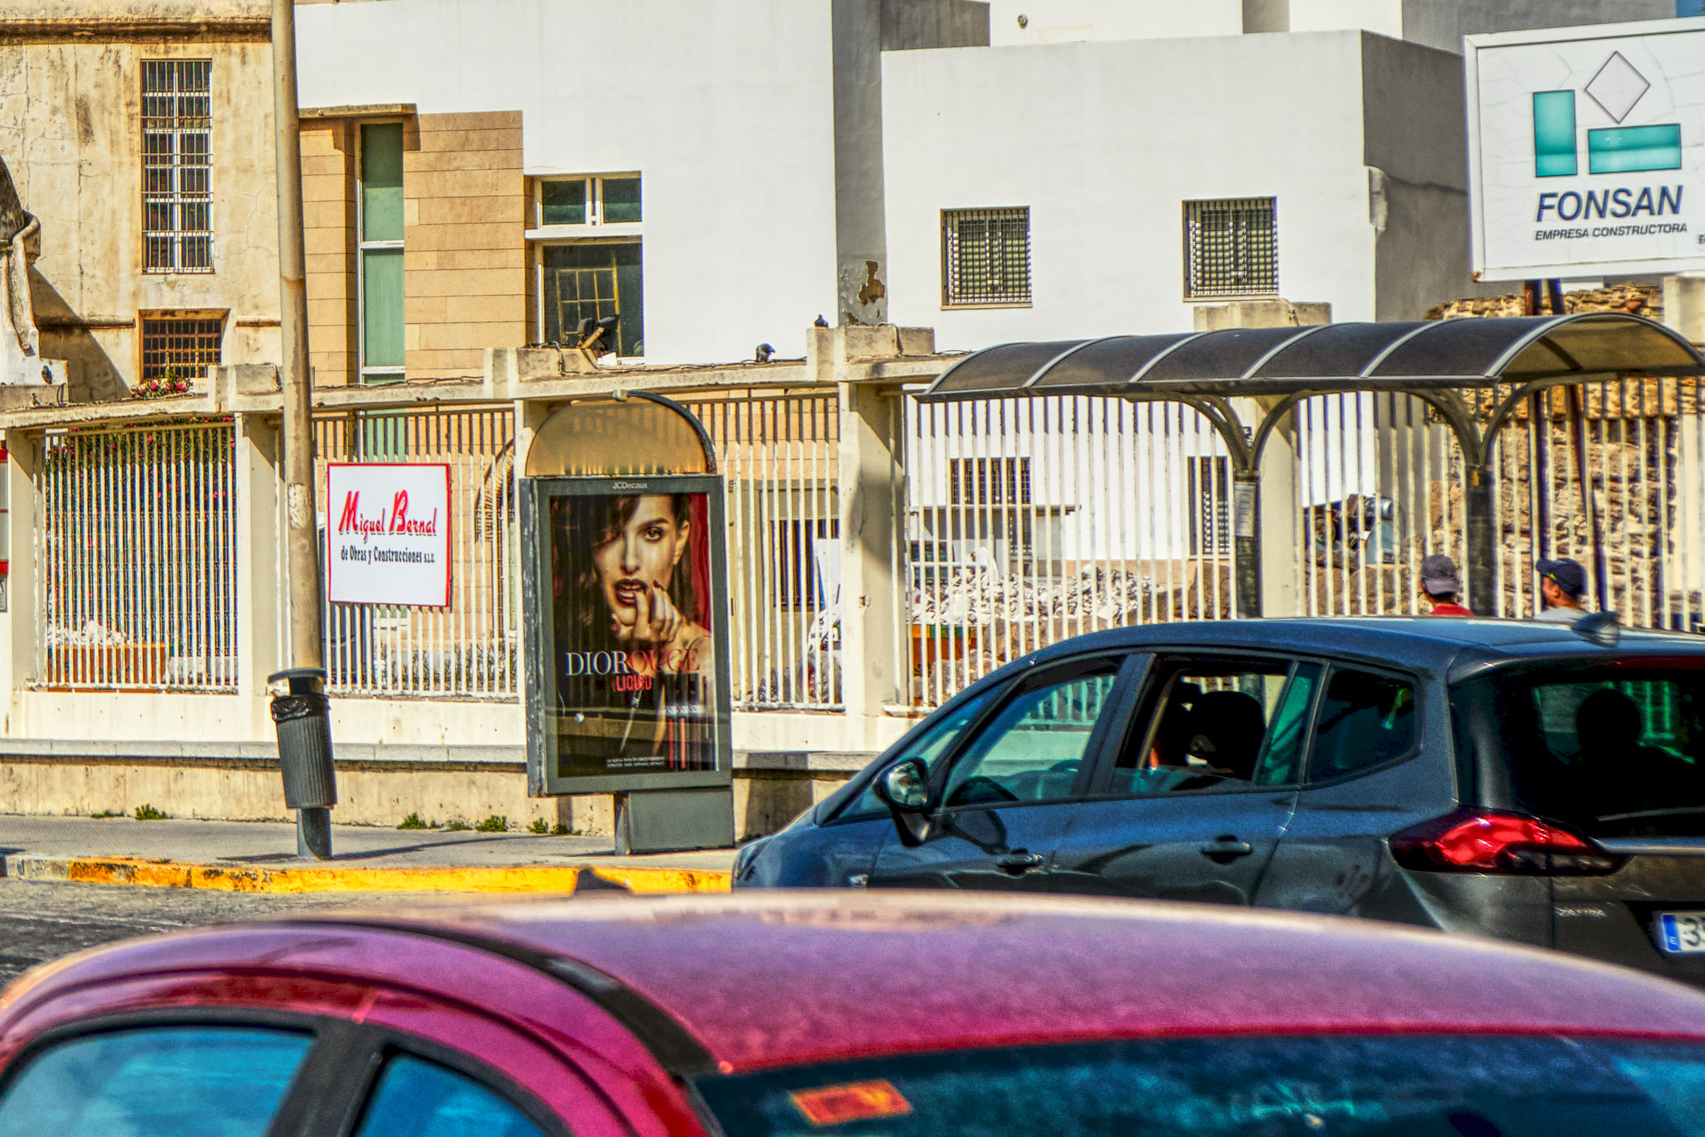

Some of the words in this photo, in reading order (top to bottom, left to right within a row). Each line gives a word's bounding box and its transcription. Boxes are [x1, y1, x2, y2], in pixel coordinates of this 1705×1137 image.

[1536, 185, 1684, 222] FONSAN
[1535, 228, 1590, 241] EMPRESA
[1592, 222, 1688, 238] CONSTRUCTORA
[338, 490, 385, 543] Miguel
[389, 489, 437, 536] Bernal
[341, 544, 349, 561] de
[350, 544, 367, 562] Obras
[368, 549, 372, 565] y
[373, 545, 423, 563] Construcciones
[615, 674, 653, 692] LIQUID
